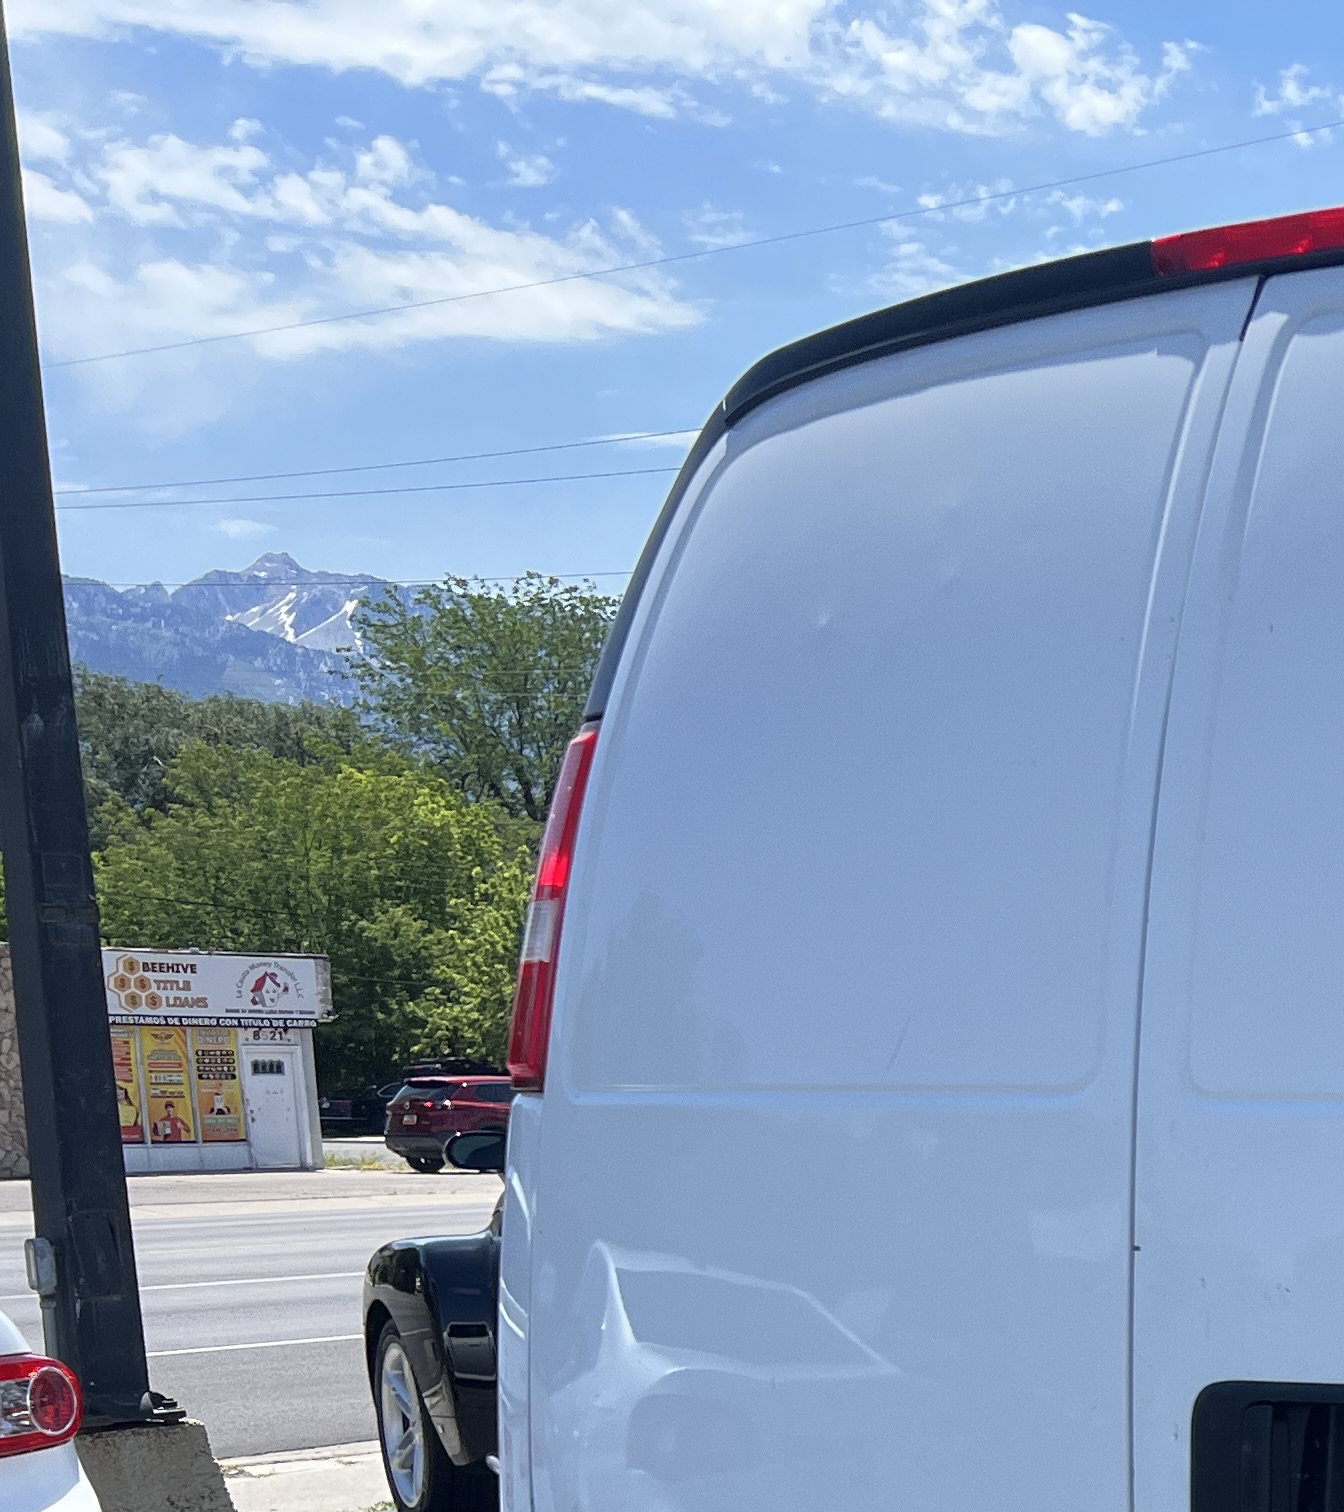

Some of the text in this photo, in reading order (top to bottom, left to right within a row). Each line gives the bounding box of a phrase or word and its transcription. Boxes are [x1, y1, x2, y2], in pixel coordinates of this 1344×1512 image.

[142, 962, 197, 974] BEEHIVE
[153, 979, 192, 991] TITLE
[165, 996, 209, 1008] LOANS
[167, 1017, 181, 1026] DE
[182, 1017, 217, 1026] DINERO
[219, 1018, 238, 1027] CON
[271, 1019, 285, 1028] DE
[286, 1019, 317, 1028] CARRO
